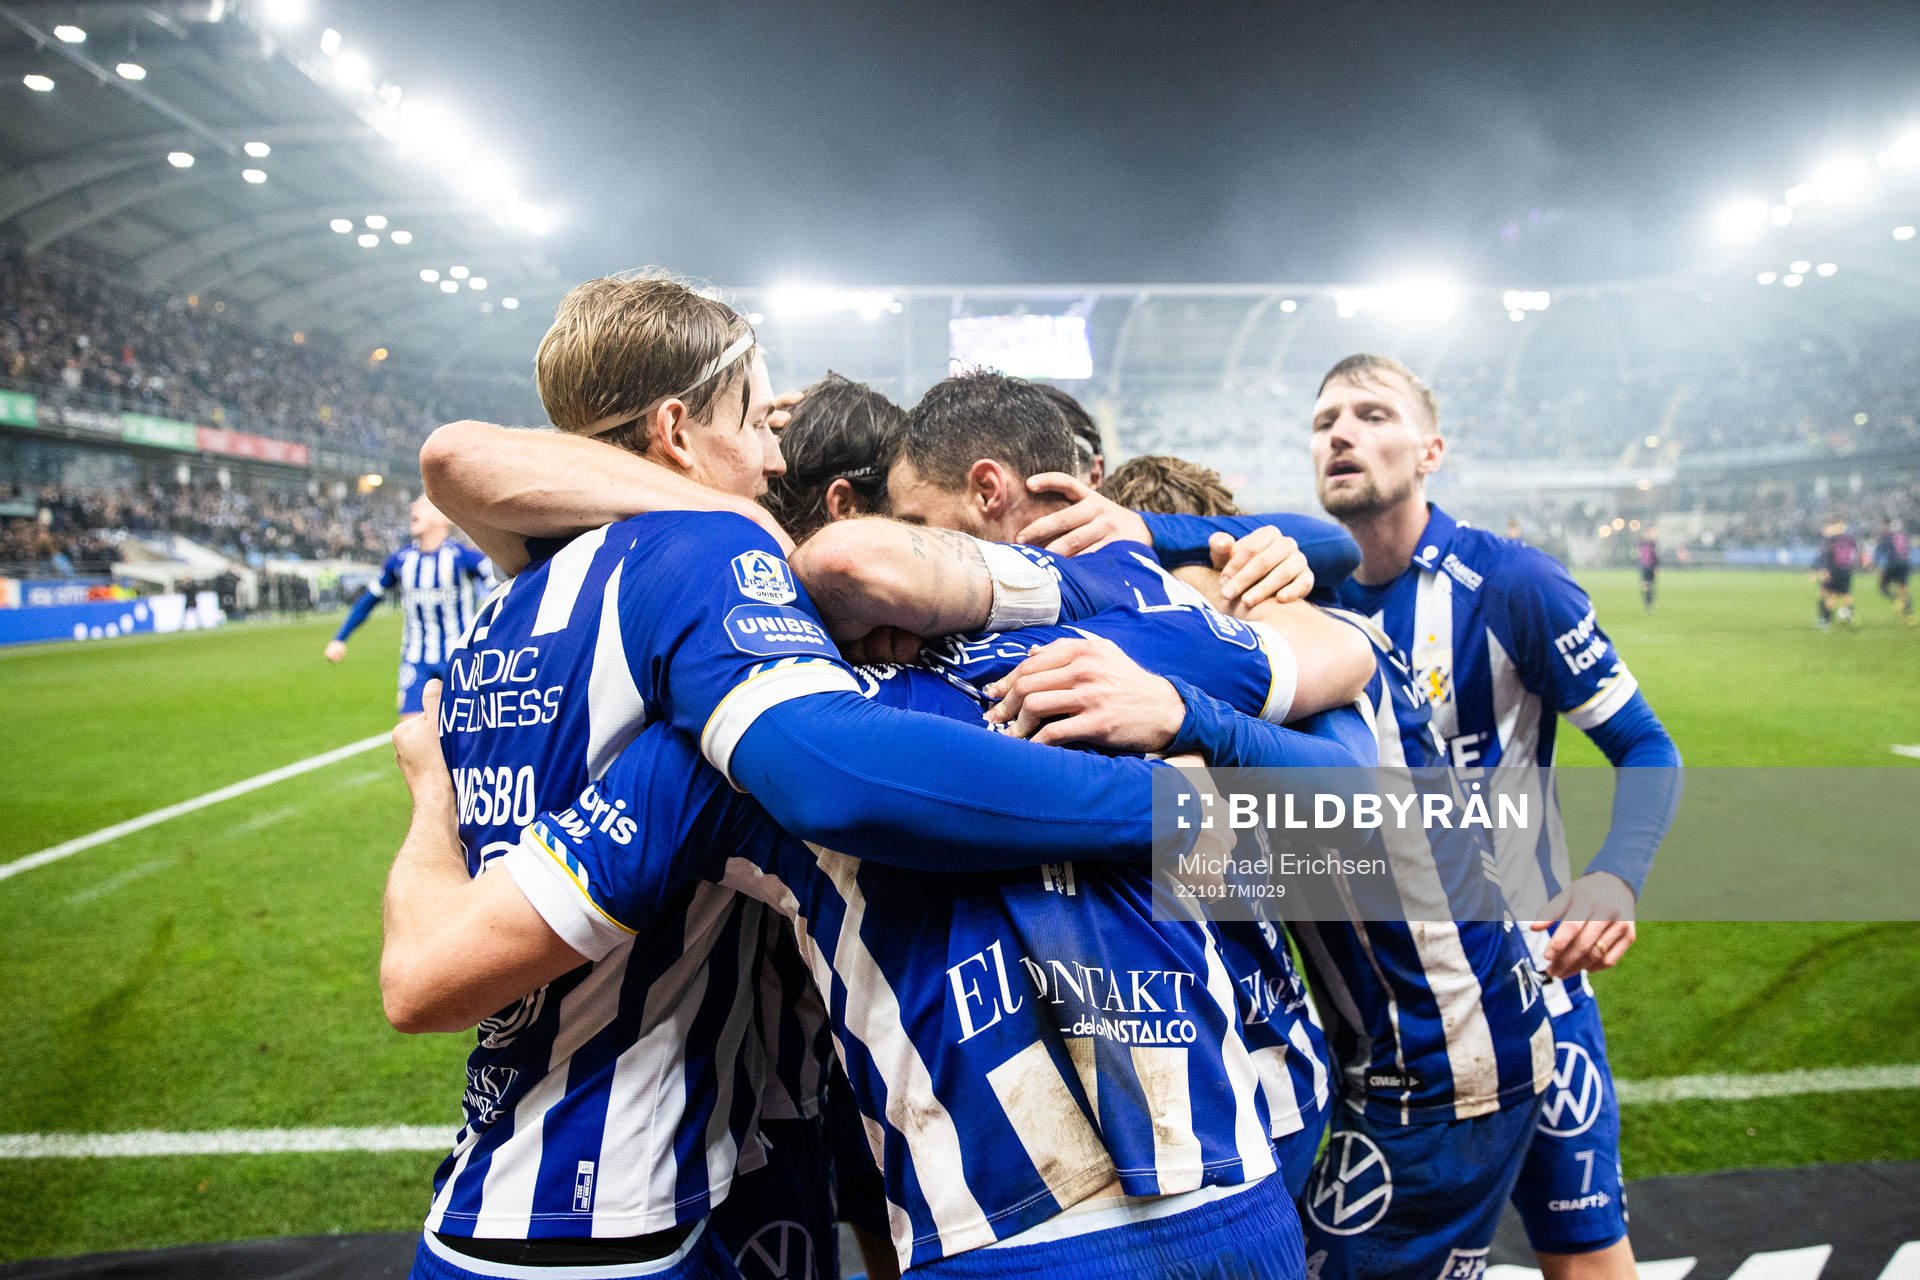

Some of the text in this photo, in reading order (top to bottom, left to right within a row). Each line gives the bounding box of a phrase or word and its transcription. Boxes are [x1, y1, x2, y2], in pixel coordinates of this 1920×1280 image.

[756, 591, 783, 599] UNIBET
[736, 616, 828, 641] UNIBET
[451, 647, 539, 692] NDIC
[1574, 1148, 1595, 1194] 7
[1548, 1193, 1598, 1211] CRAFT
